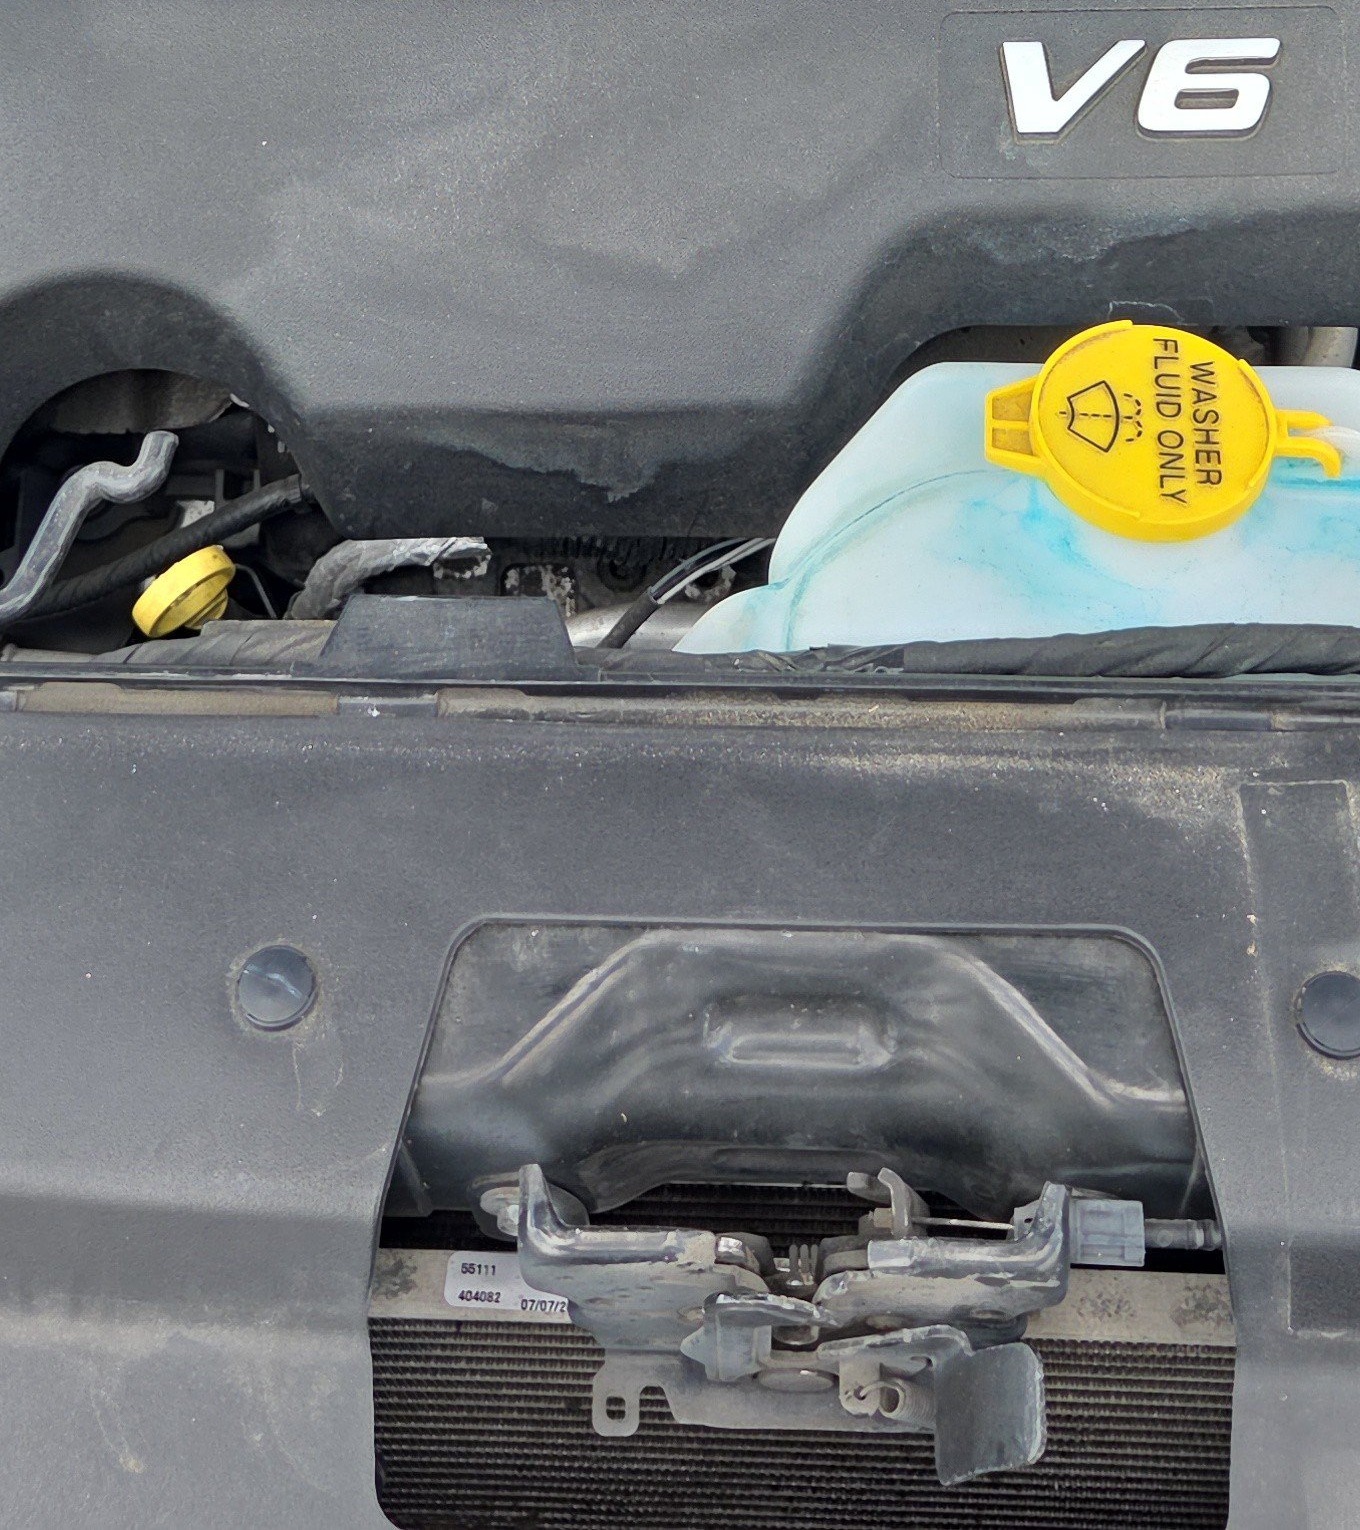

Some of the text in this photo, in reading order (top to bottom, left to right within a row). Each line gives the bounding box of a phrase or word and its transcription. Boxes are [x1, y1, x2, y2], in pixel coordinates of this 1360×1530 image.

[1000, 37, 1282, 145] V6
[1152, 338, 1188, 504] FLUID ONLY
[1189, 361, 1223, 486] WASHER
[457, 1290, 501, 1304] 404082
[460, 1262, 497, 1276] 55111
